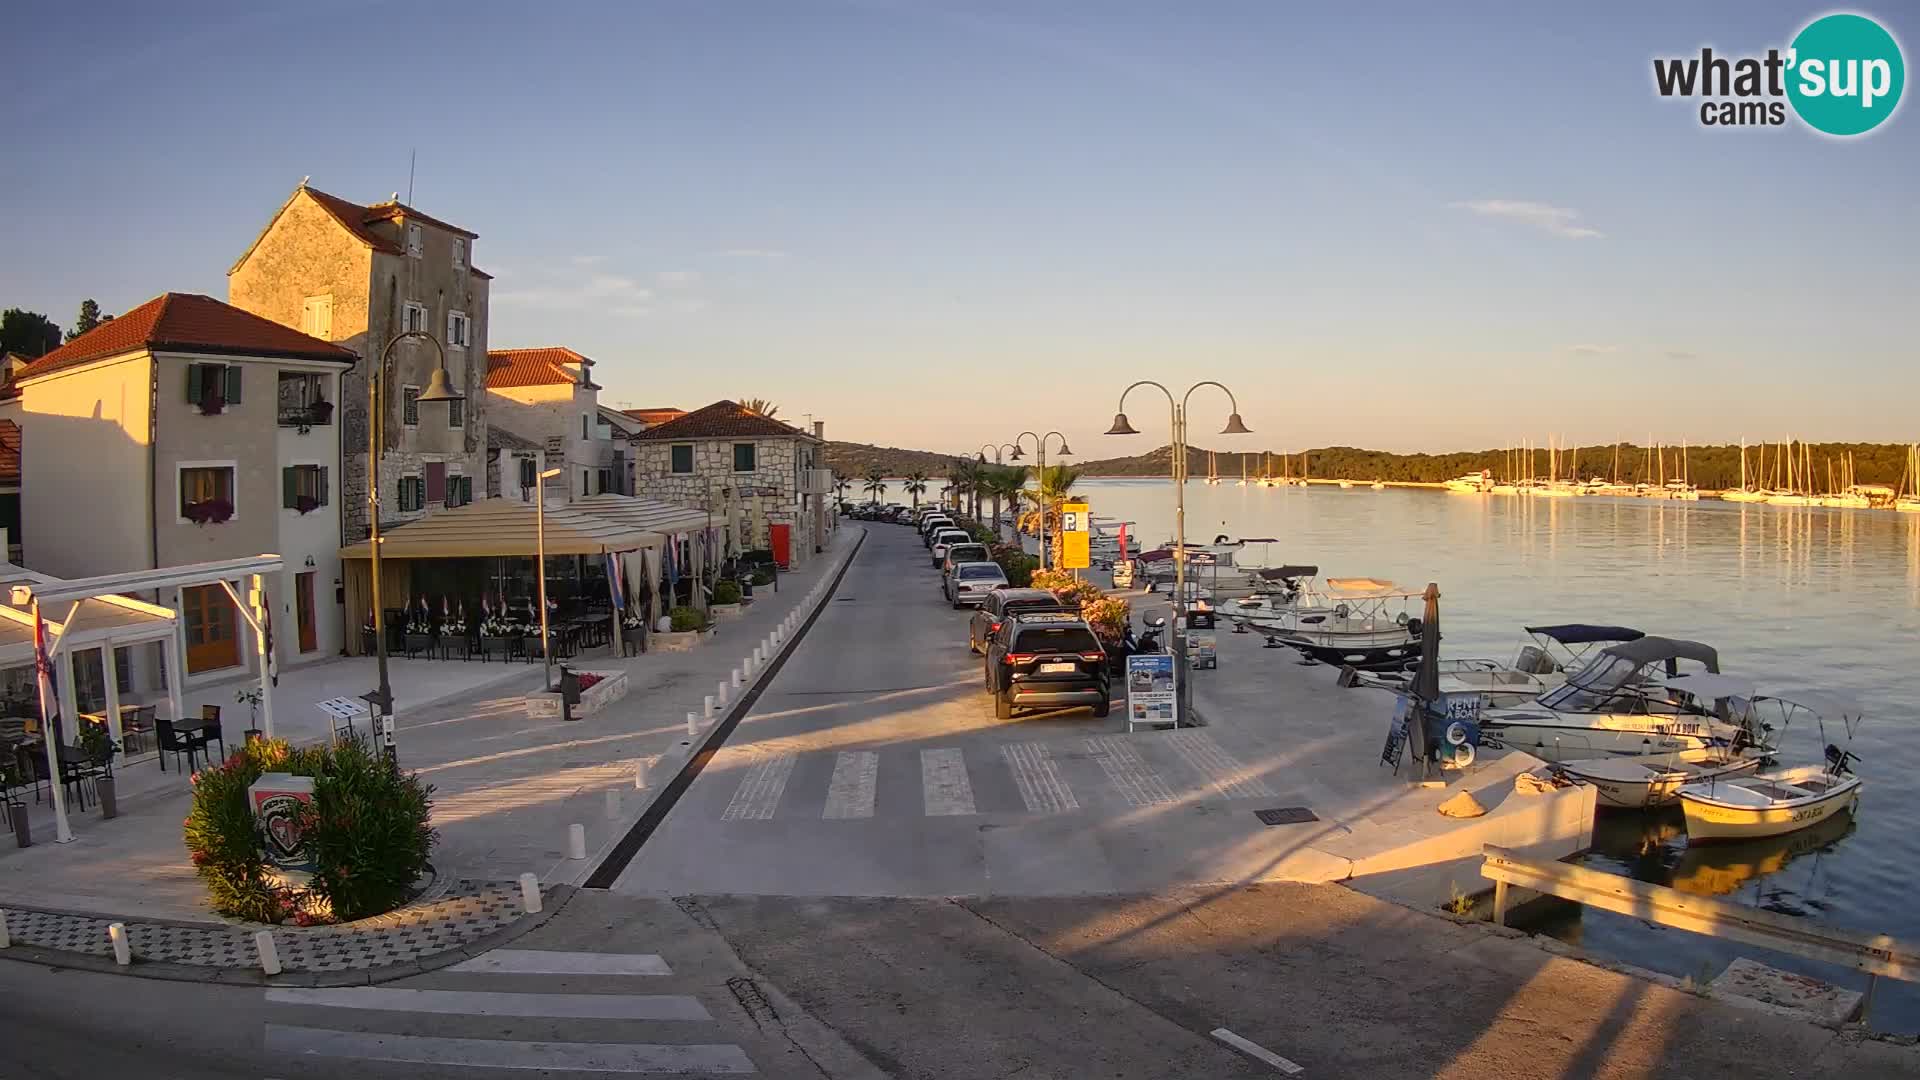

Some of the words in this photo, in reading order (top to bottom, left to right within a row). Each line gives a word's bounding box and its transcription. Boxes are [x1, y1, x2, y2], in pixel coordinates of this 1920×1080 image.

[1064, 513, 1076, 531] P
[1447, 698, 1479, 710] RENT
[1446, 710, 1453, 719] A
[1454, 709, 1478, 719] BOAT
[1682, 723, 1700, 735] BOAT
